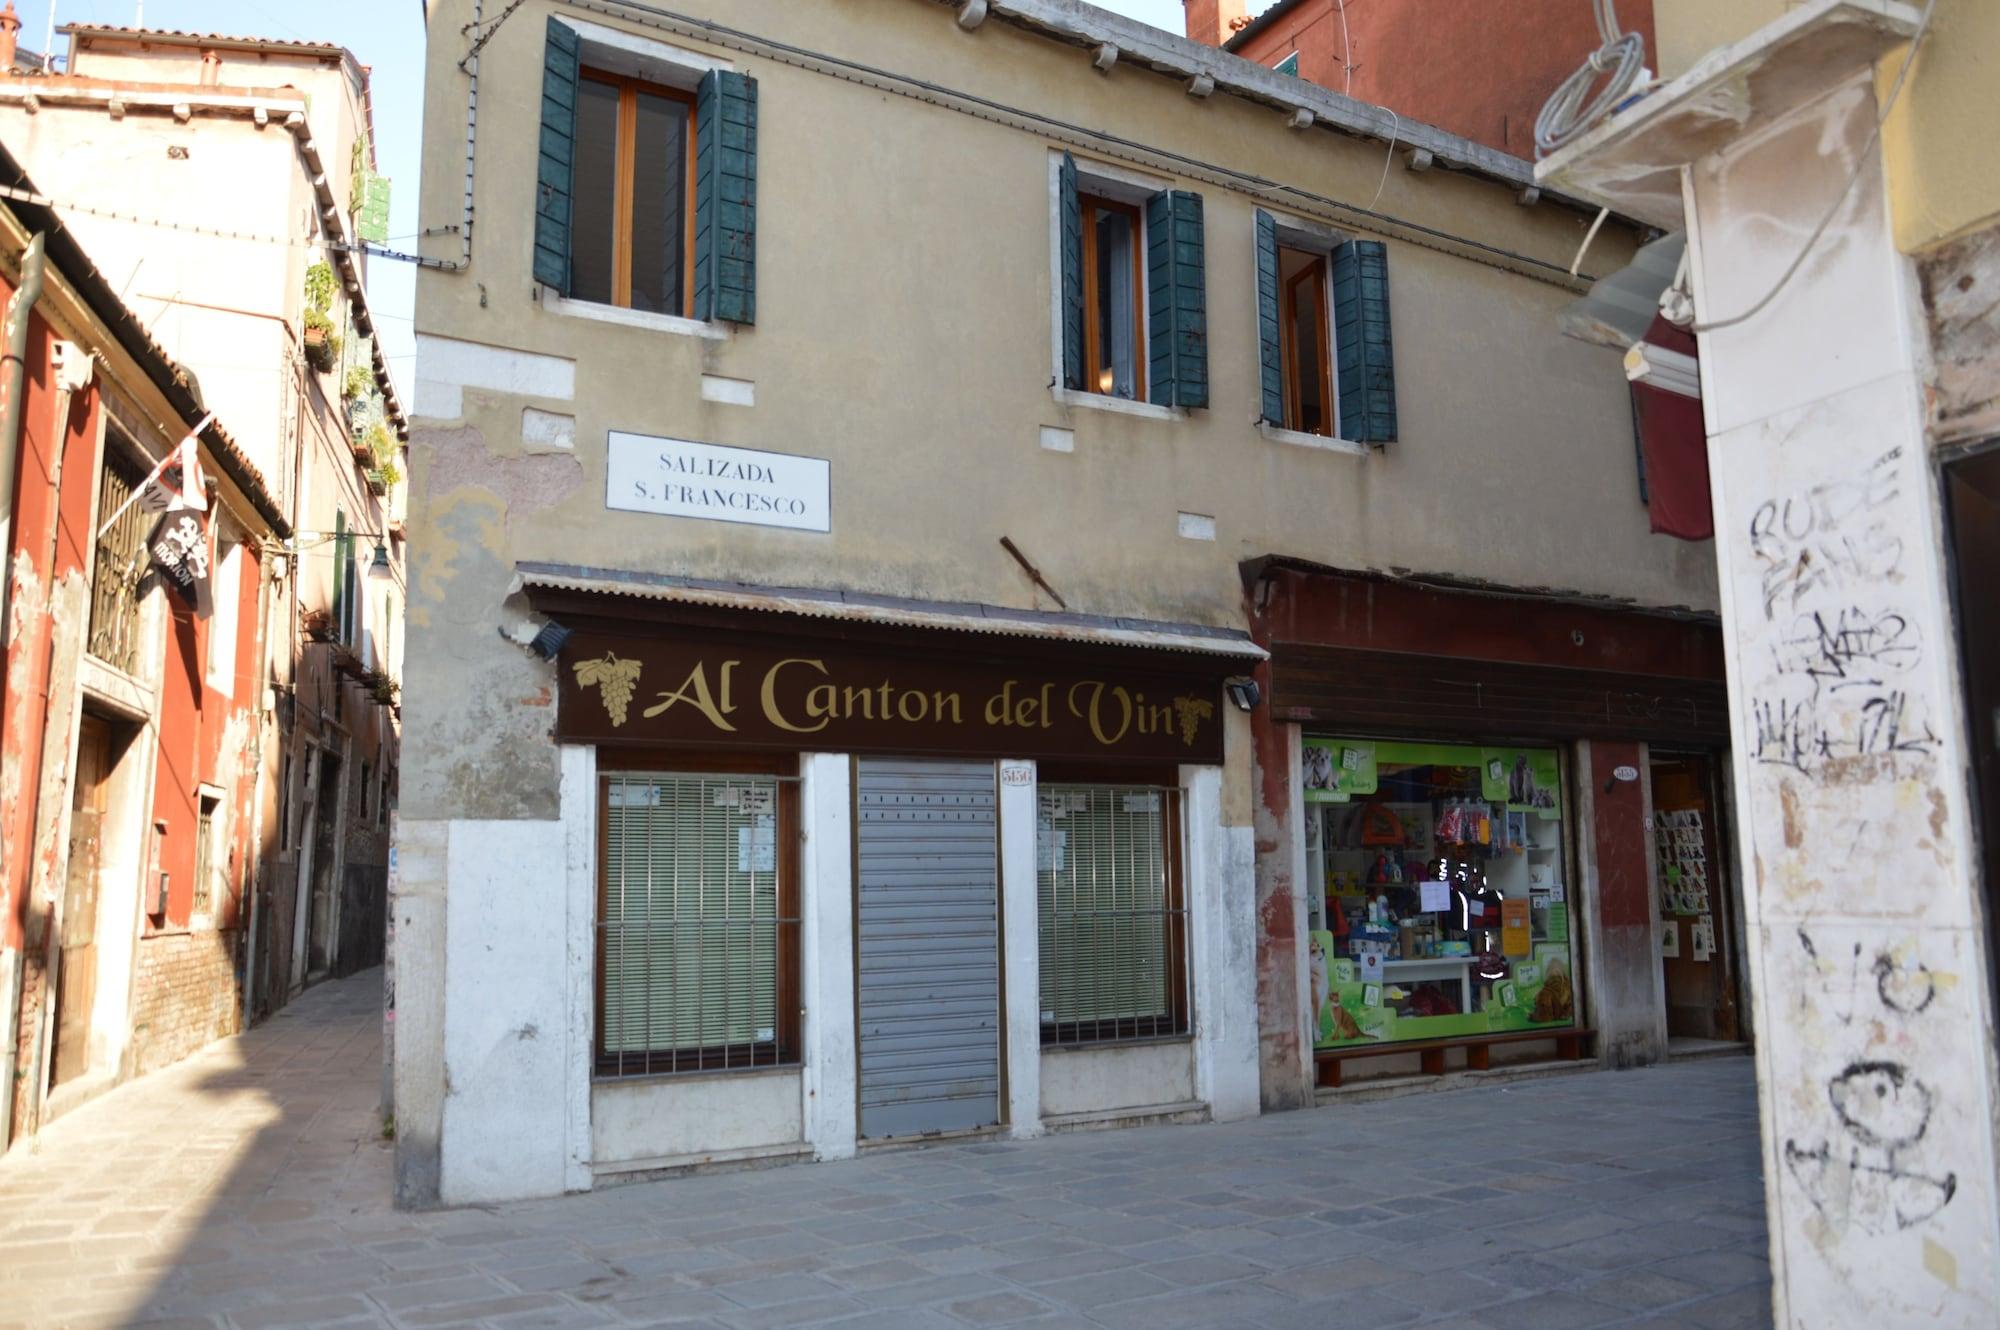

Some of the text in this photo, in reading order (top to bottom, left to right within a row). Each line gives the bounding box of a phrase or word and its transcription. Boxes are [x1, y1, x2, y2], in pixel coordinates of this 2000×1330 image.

[659, 453, 775, 484] SALIZADA
[634, 480, 806, 516] S. FRANCESCO
[154, 541, 193, 587] MORION
[643, 658, 1175, 745] Al Canton del Vin
